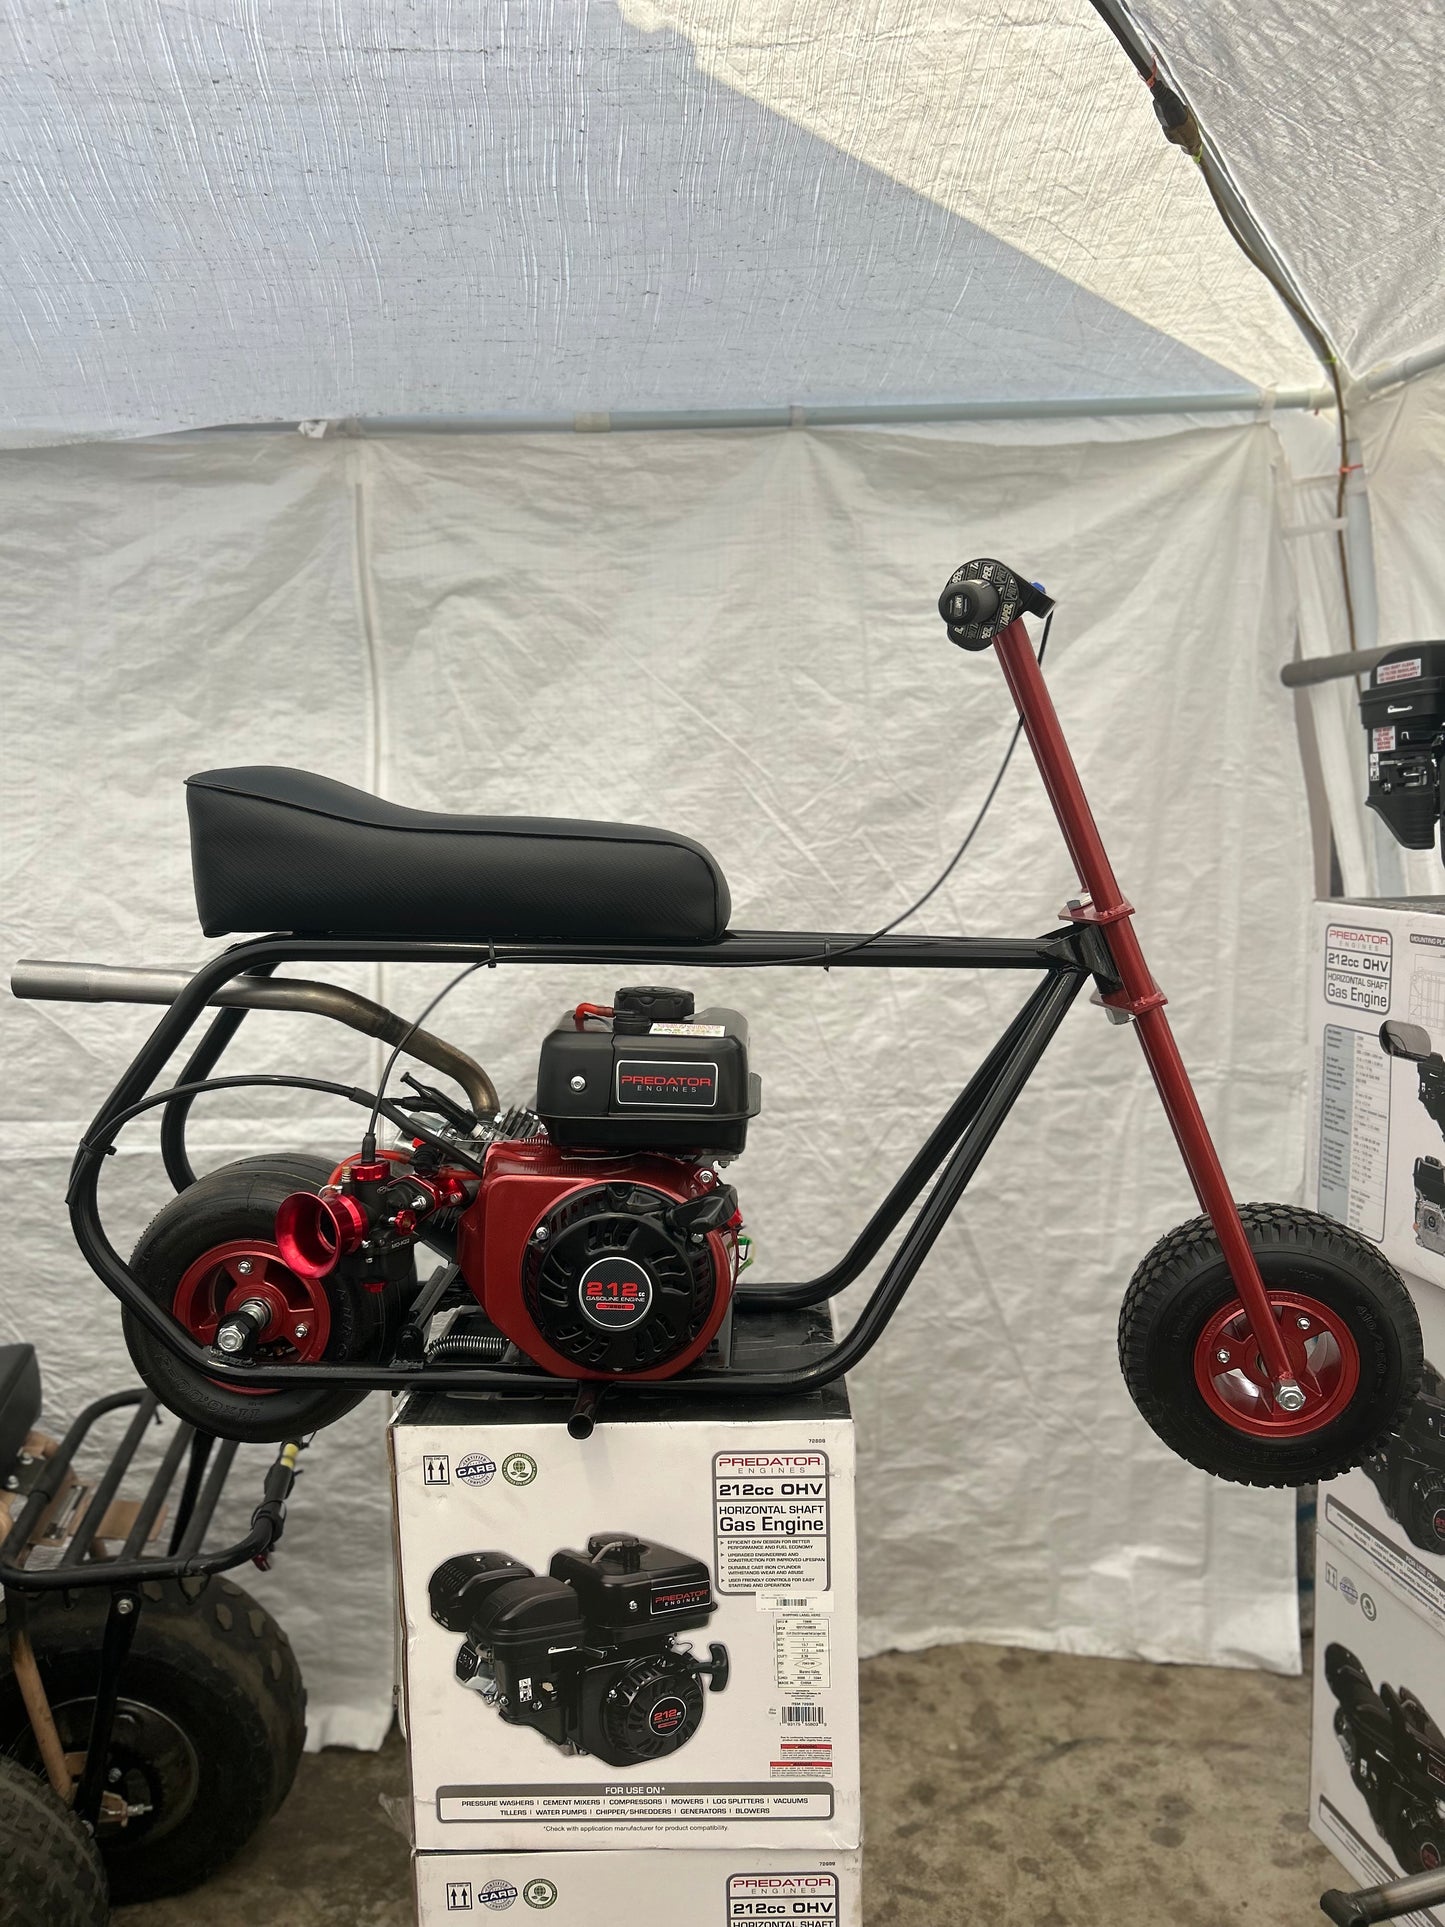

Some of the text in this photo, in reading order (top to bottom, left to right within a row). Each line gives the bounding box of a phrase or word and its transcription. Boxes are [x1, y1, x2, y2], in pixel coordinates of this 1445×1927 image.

[1330, 930, 1388, 945] PREDATOR
[1411, 935, 1436, 945] MOUNTING
[1340, 941, 1379, 952] ENGINES
[1328, 953, 1388, 972] 212cc OHV
[1328, 973, 1388, 990] HORIZONTAL SHAFT
[1328, 983, 1387, 1007] Gas Engine
[621, 1076, 712, 1087] PREDATOR
[587, 1281, 638, 1296] 212
[719, 1457, 821, 1466] PREDATOR
[458, 1463, 495, 1476] CARB
[720, 1483, 823, 1495] 212cc OHV
[720, 1505, 824, 1514] HORIZONTAL SHAFT
[720, 1516, 824, 1535] Gas Engine
[655, 1590, 708, 1603] PREDATOR
[665, 1597, 700, 1606] ENGINES
[654, 1709, 677, 1721] 212
[733, 1878, 831, 1888] PREDATOR
[480, 1888, 516, 1901] CARB
[733, 1903, 832, 1914] 212cc OHV
